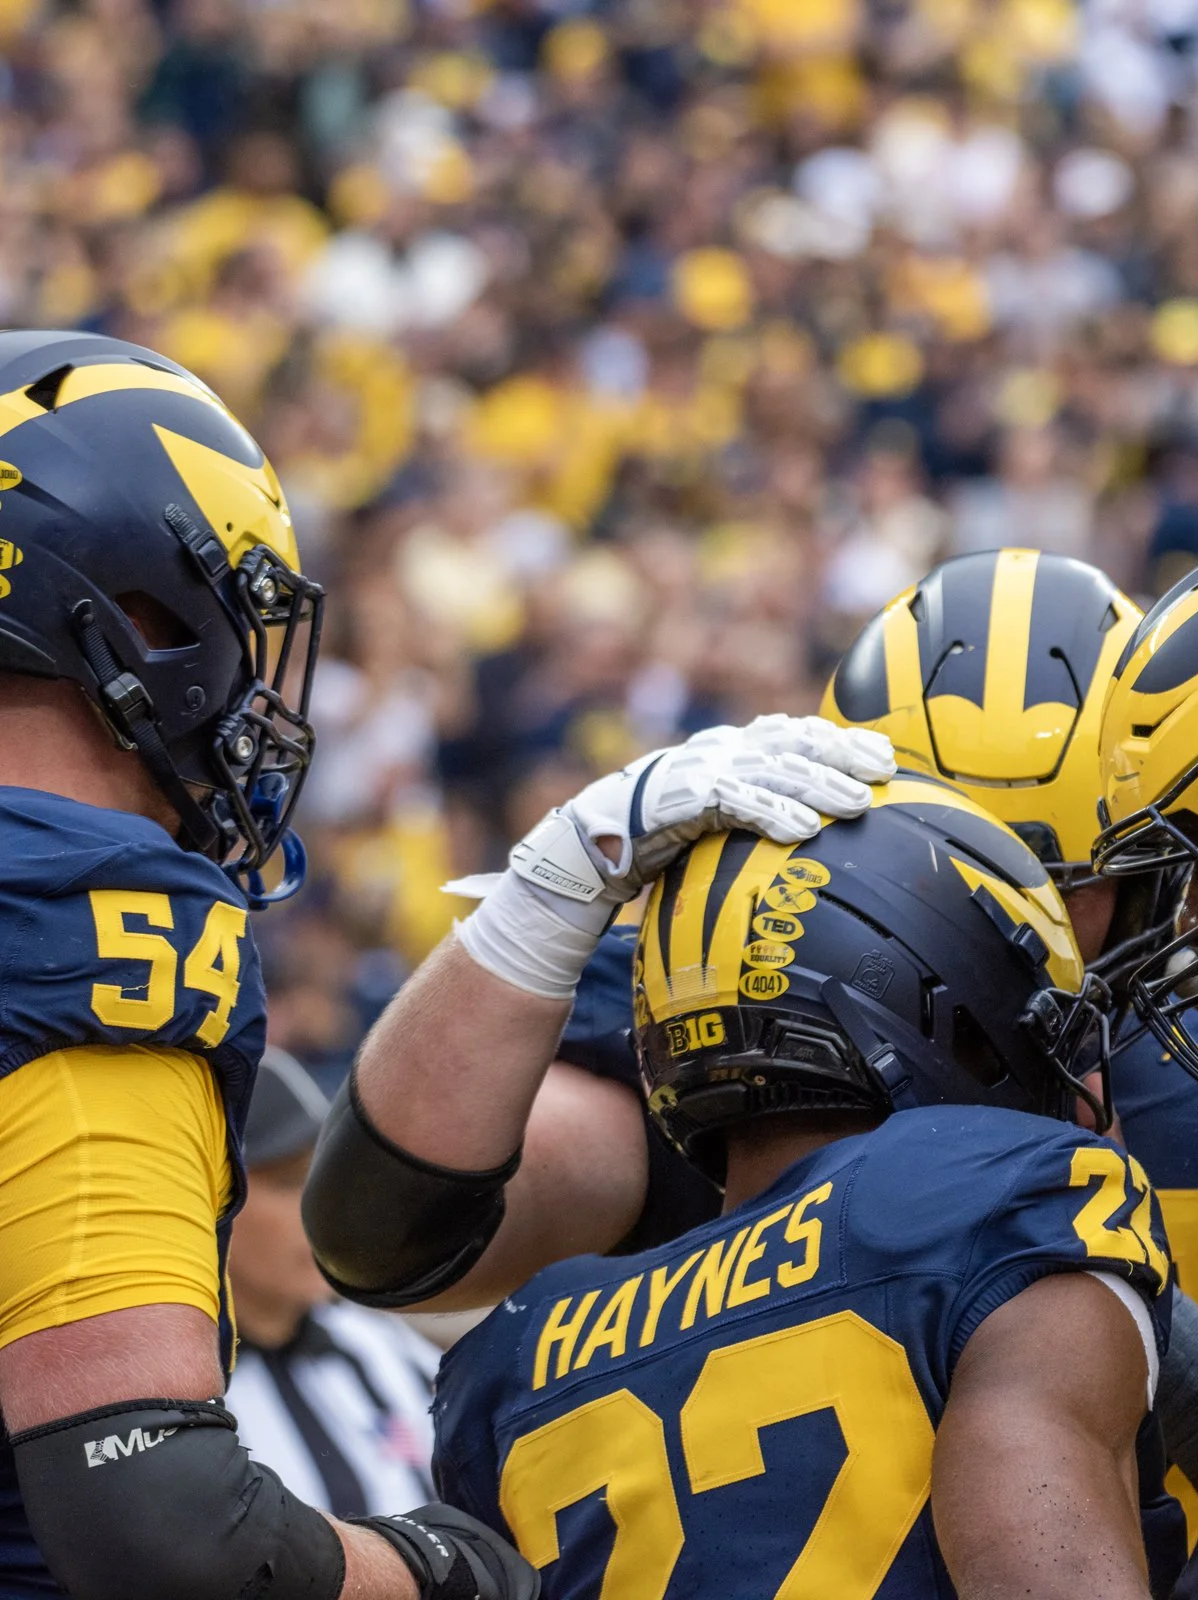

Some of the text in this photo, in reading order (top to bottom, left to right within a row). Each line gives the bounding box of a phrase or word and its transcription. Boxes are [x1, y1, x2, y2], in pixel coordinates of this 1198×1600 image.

[89, 889, 247, 1048] 54
[744, 975, 783, 993] (404)
[750, 953, 787, 965] EQUALITY
[762, 916, 796, 936] TED
[532, 1182, 833, 1391] HAYNES
[1069, 1147, 1170, 1296] 22
[499, 1310, 937, 1600] 22
